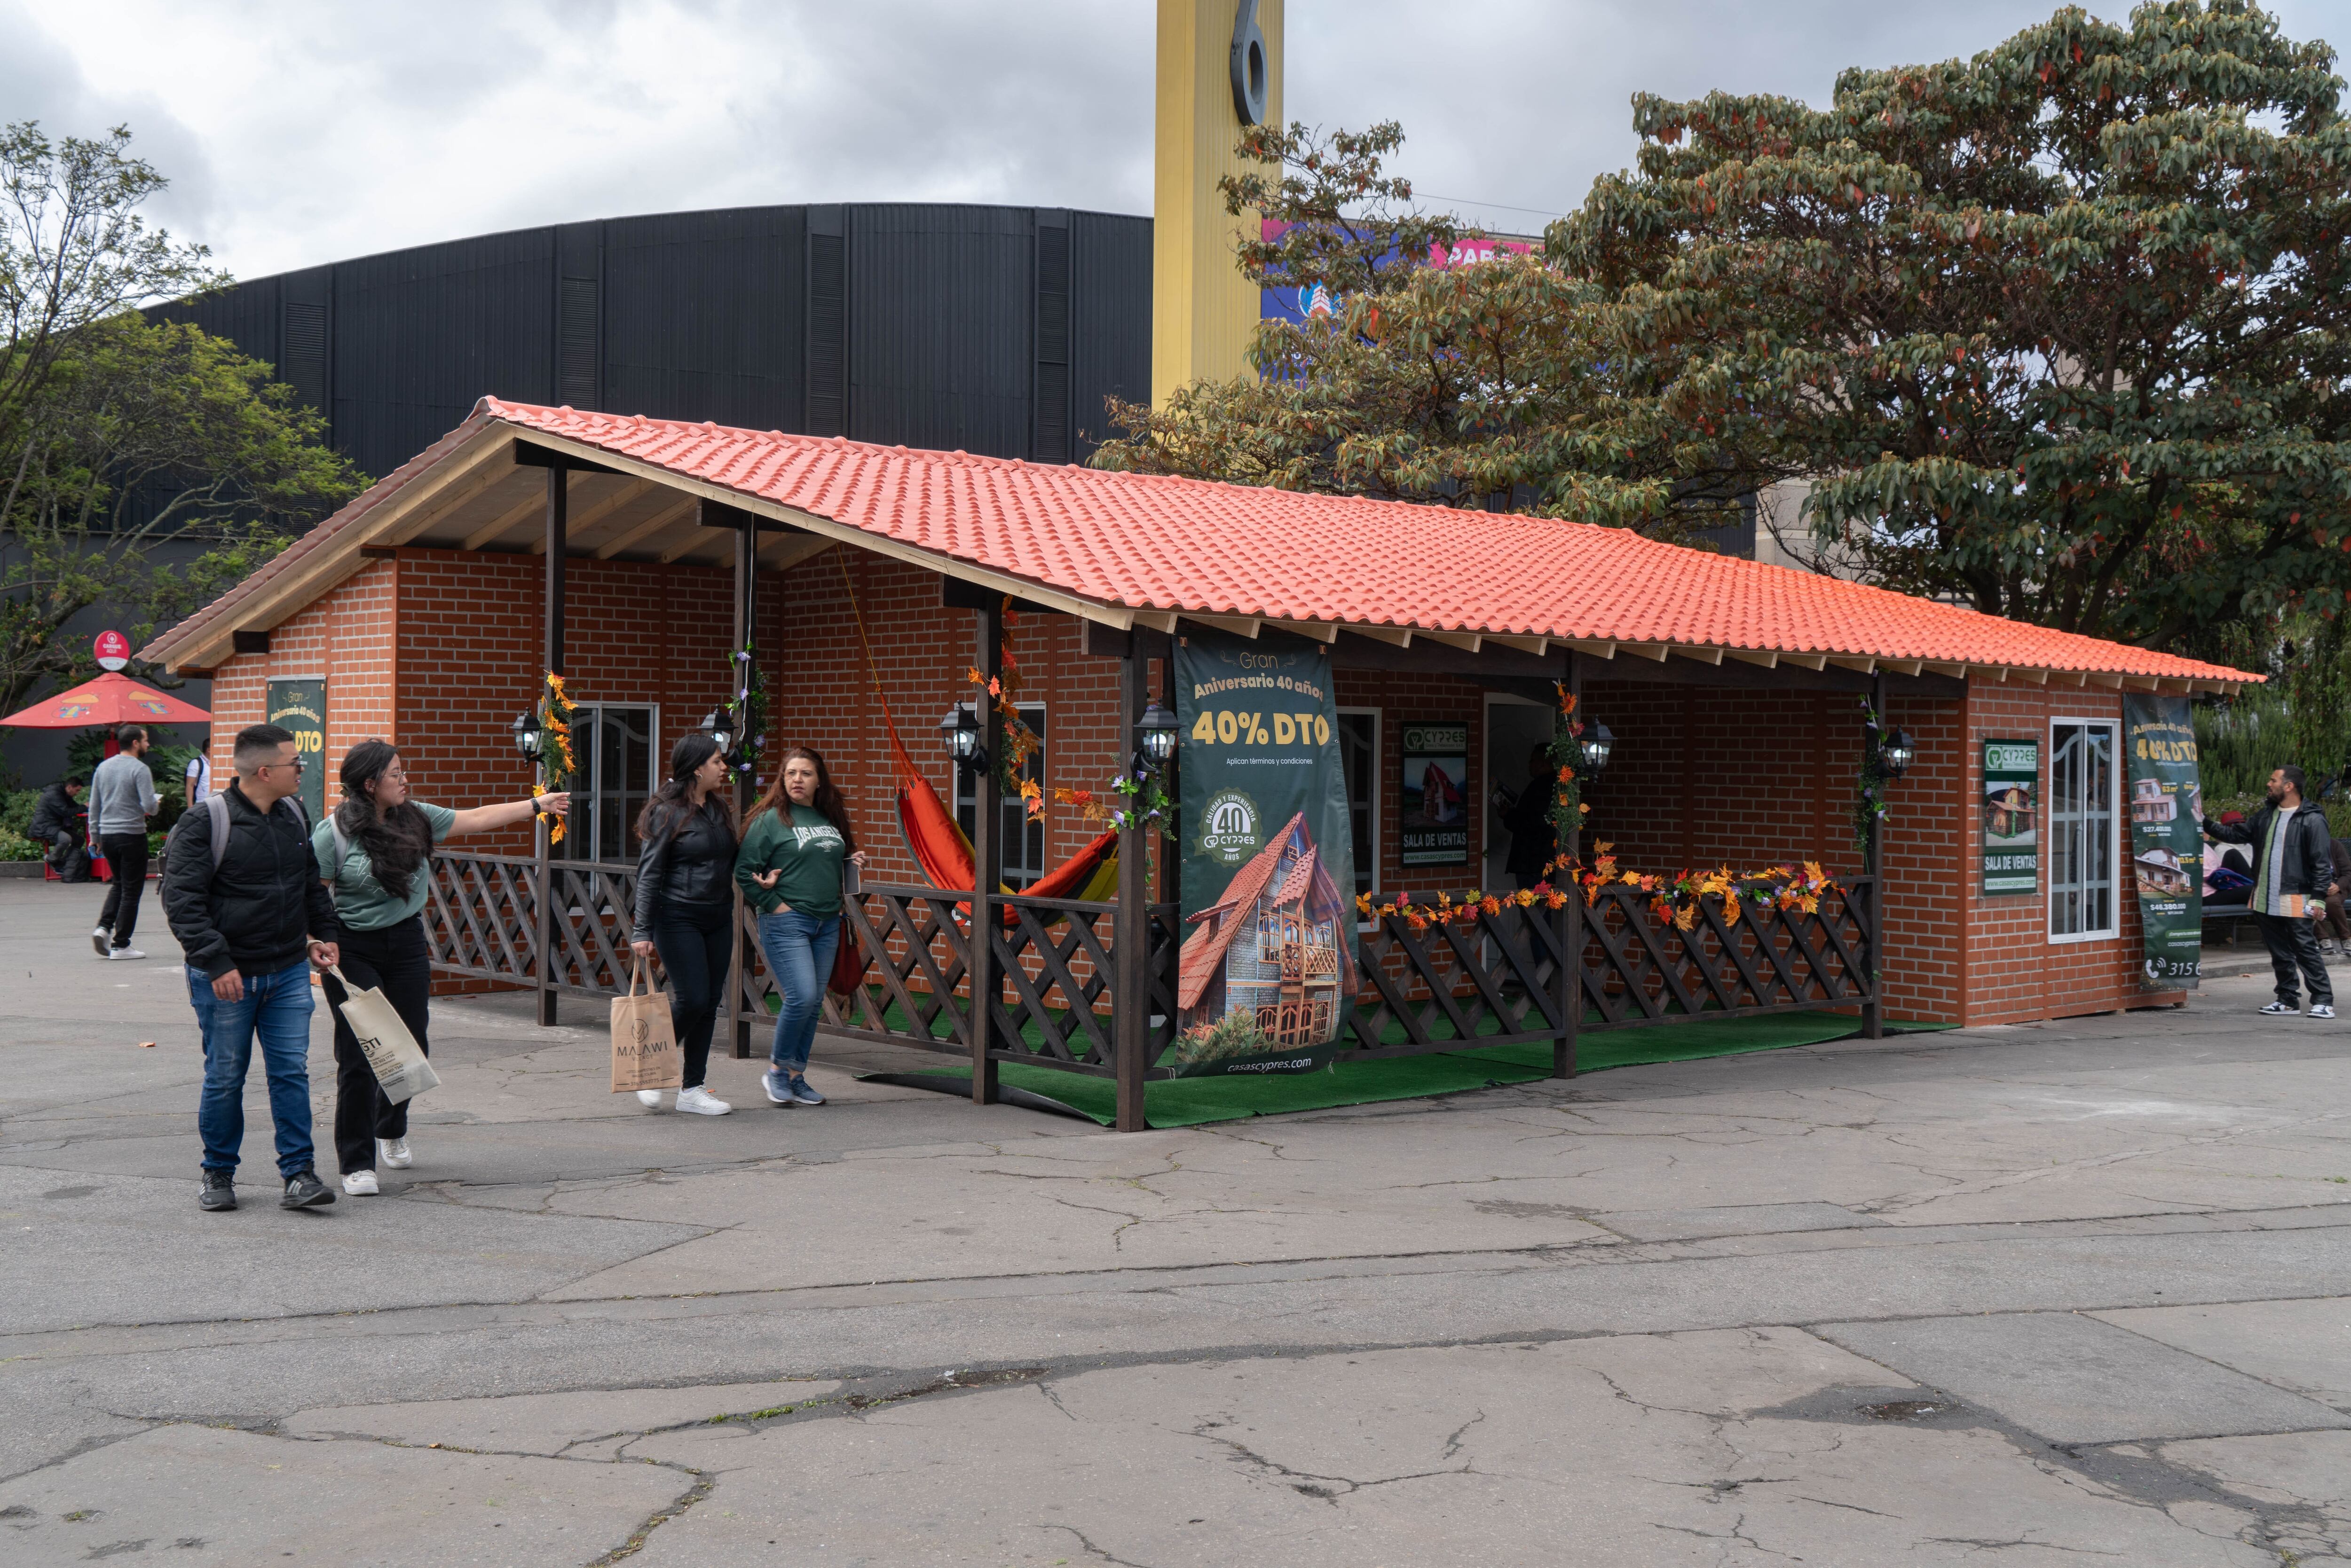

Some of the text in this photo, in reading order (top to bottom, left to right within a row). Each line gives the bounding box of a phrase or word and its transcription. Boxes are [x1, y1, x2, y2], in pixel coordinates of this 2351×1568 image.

[1240, 652, 1278, 670] Gran
[1194, 673, 1324, 702] Aniversario 40 años
[288, 692, 302, 703] Gran
[270, 705, 320, 724] Aniversario 40 años
[1192, 710, 1330, 746] 40% DTO
[295, 731, 322, 753] DTO
[1425, 731, 1465, 742] CYPRES
[2004, 749, 2035, 762] CYPRES
[2137, 739, 2171, 761] 40%
[1206, 798, 1222, 824] CALIDAD
[1228, 795, 1256, 822] EXPERIENCIA
[1217, 807, 1243, 833] 40
[792, 826, 845, 851] LOS ANGEL
[1221, 835, 1255, 844] CYPRES
[1404, 832, 1466, 847] SALA DE VENTAS
[1404, 852, 1466, 861] www.casascypres.com
[1985, 855, 2036, 870] SALA DE VENTAS
[1986, 879, 2035, 888] www.casascypres.com
[2168, 962, 2193, 976] 315
[360, 1037, 381, 1052] GTI
[617, 1040, 667, 1056] MAAWI
[1228, 1057, 1311, 1072] casascypres.com
